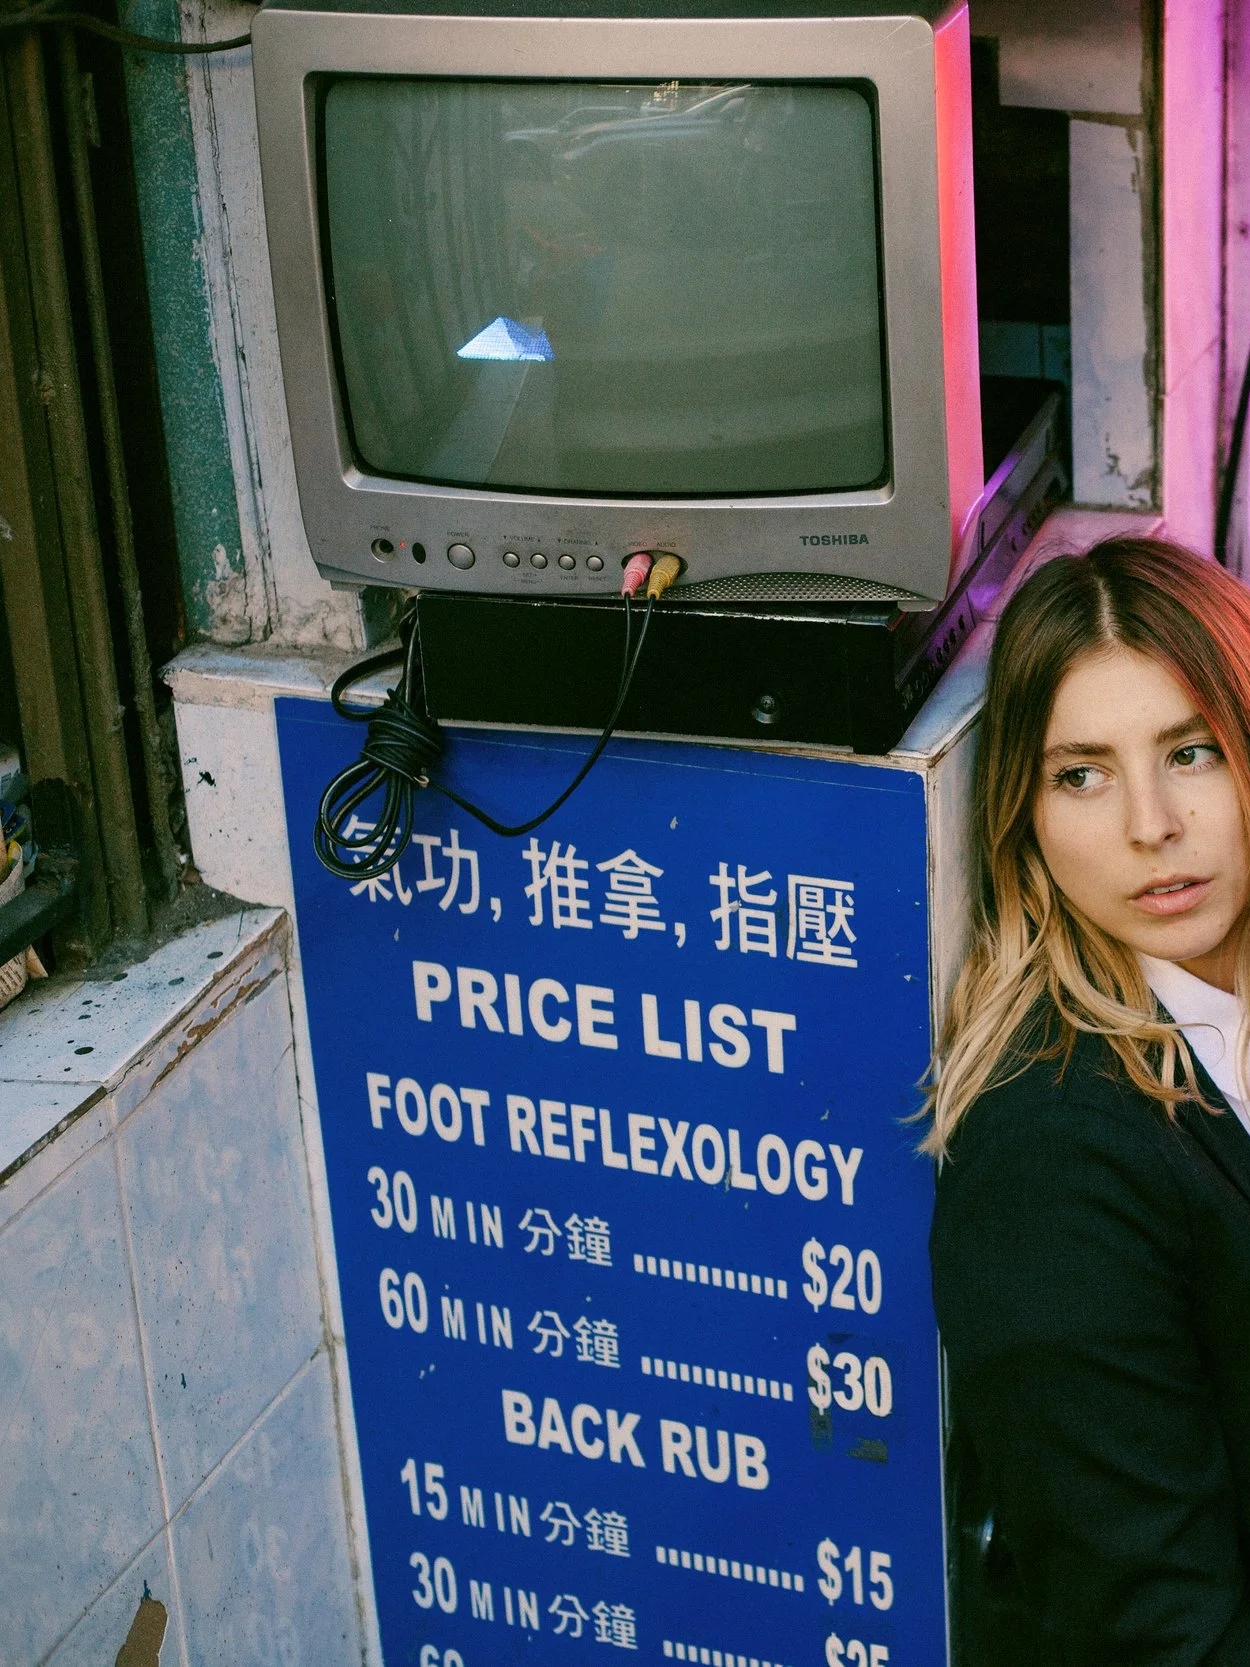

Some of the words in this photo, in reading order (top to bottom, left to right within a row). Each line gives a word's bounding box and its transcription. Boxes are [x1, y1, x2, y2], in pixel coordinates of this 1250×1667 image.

[799, 534, 869, 546] TOSHIBA
[412, 960, 618, 1050] PRICE
[641, 993, 797, 1074] LIST
[366, 1072, 490, 1146] FOOT
[506, 1094, 864, 1206] REFLEXOLOGY
[367, 1166, 418, 1233] 30
[430, 1195, 503, 1248] MIN
[518, 1208, 613, 1268] 分鐘
[802, 1237, 882, 1315] $20
[379, 1267, 428, 1333] 60
[441, 1296, 513, 1349] MIN
[527, 1310, 621, 1369] 分鐘
[807, 1342, 893, 1417] $30
[501, 1389, 646, 1467] BACK
[660, 1419, 769, 1490] RUB
[401, 1458, 448, 1520] 15
[460, 1486, 531, 1537] MIN
[539, 1501, 631, 1557] 分鐘
[817, 1537, 894, 1611] $15
[409, 1552, 457, 1614] 30
[469, 1580, 539, 1630] MIN
[547, 1595, 638, 1650] 分鐘
